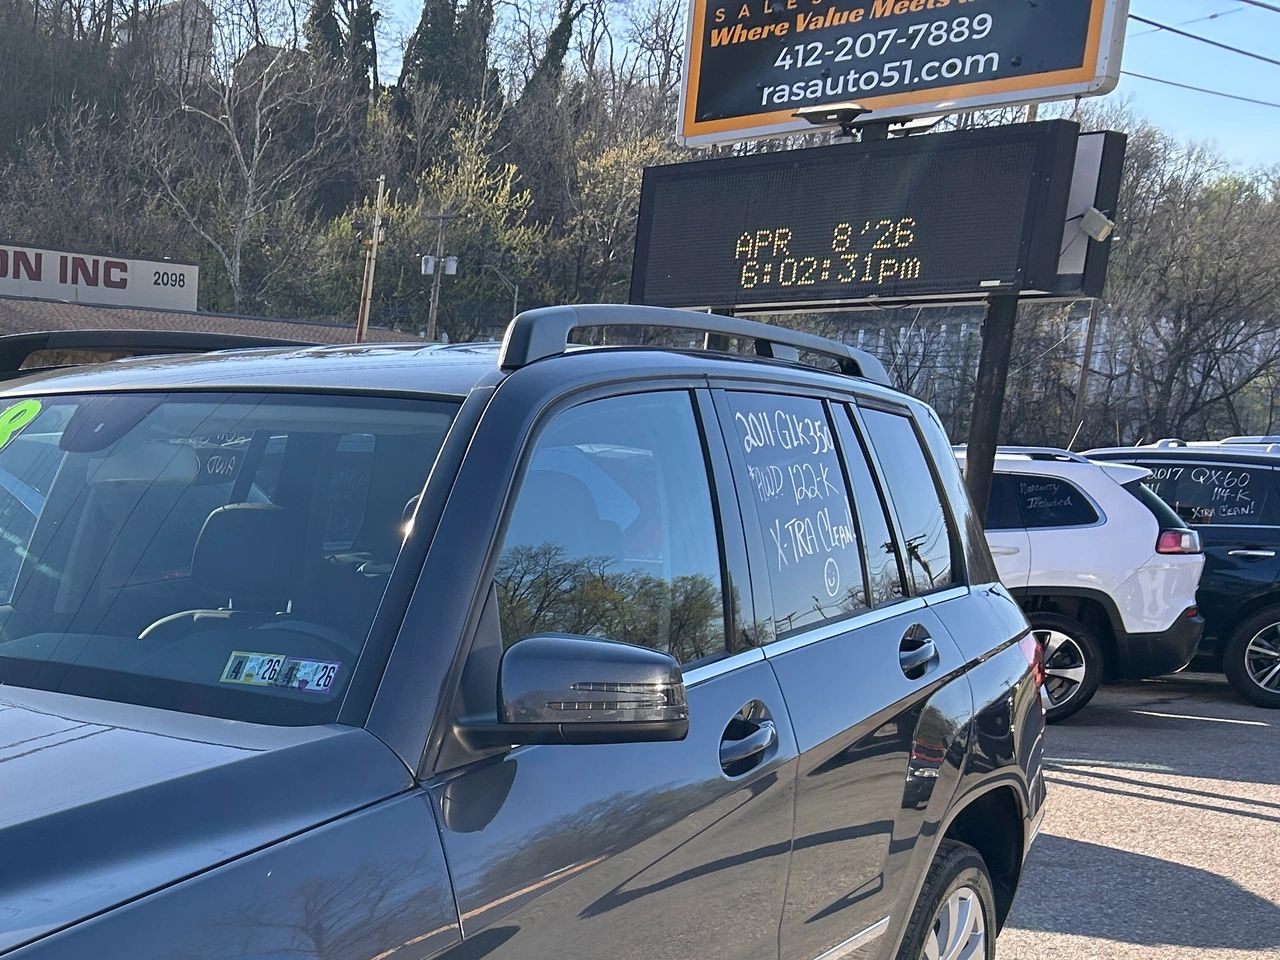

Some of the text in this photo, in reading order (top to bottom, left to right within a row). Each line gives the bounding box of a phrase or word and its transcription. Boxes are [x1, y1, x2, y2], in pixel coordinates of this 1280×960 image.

[710, 22, 790, 47] Where
[796, 6, 864, 32] Value
[773, 13, 993, 71] 412-207-7889
[761, 51, 1000, 105] rasauto51.com
[735, 228, 792, 259] APR
[59, 255, 128, 290] INC
[153, 271, 186, 288] 2098
[741, 253, 921, 288] 6:02:31pm
[261, 659, 281, 681] 26
[316, 665, 336, 688] 26
